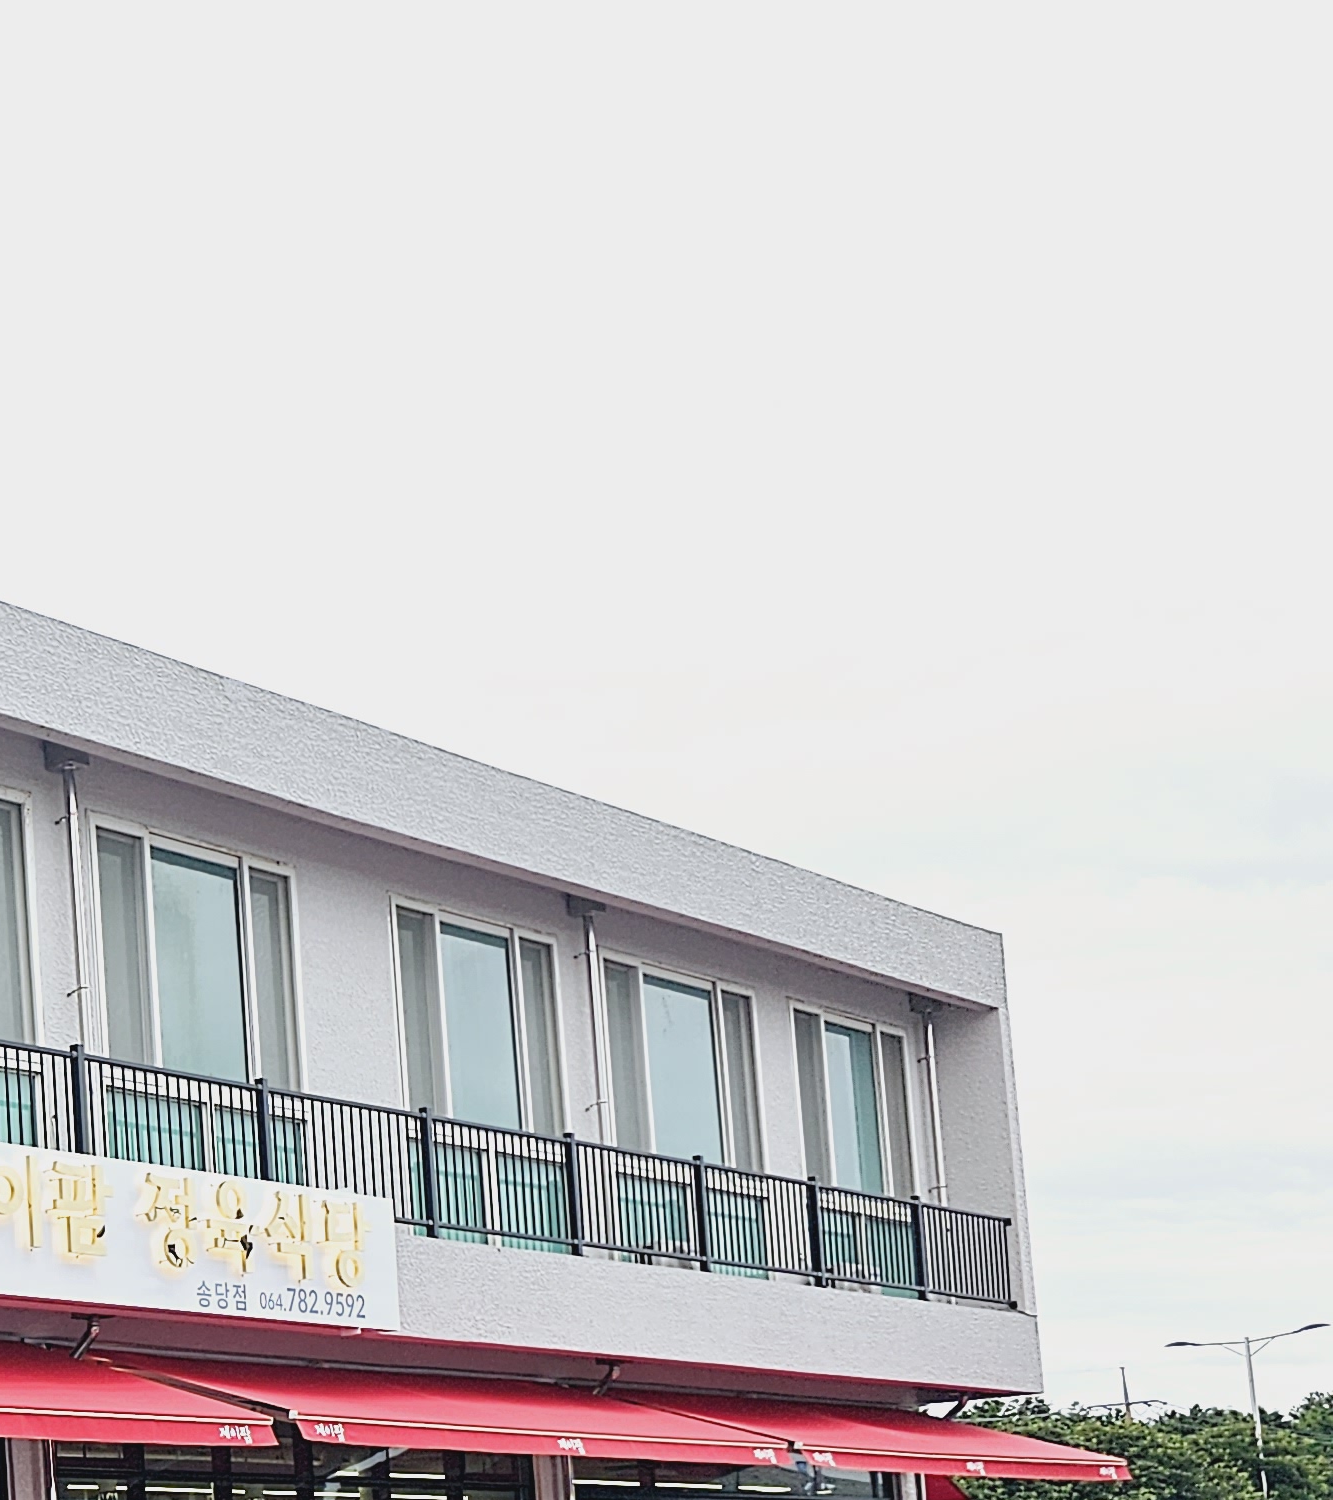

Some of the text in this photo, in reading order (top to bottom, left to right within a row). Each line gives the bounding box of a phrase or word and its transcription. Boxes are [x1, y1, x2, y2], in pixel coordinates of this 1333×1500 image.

[134, 1172, 372, 1289] 정육식당
[196, 1280, 366, 1319] 송당점 064.782.9592
